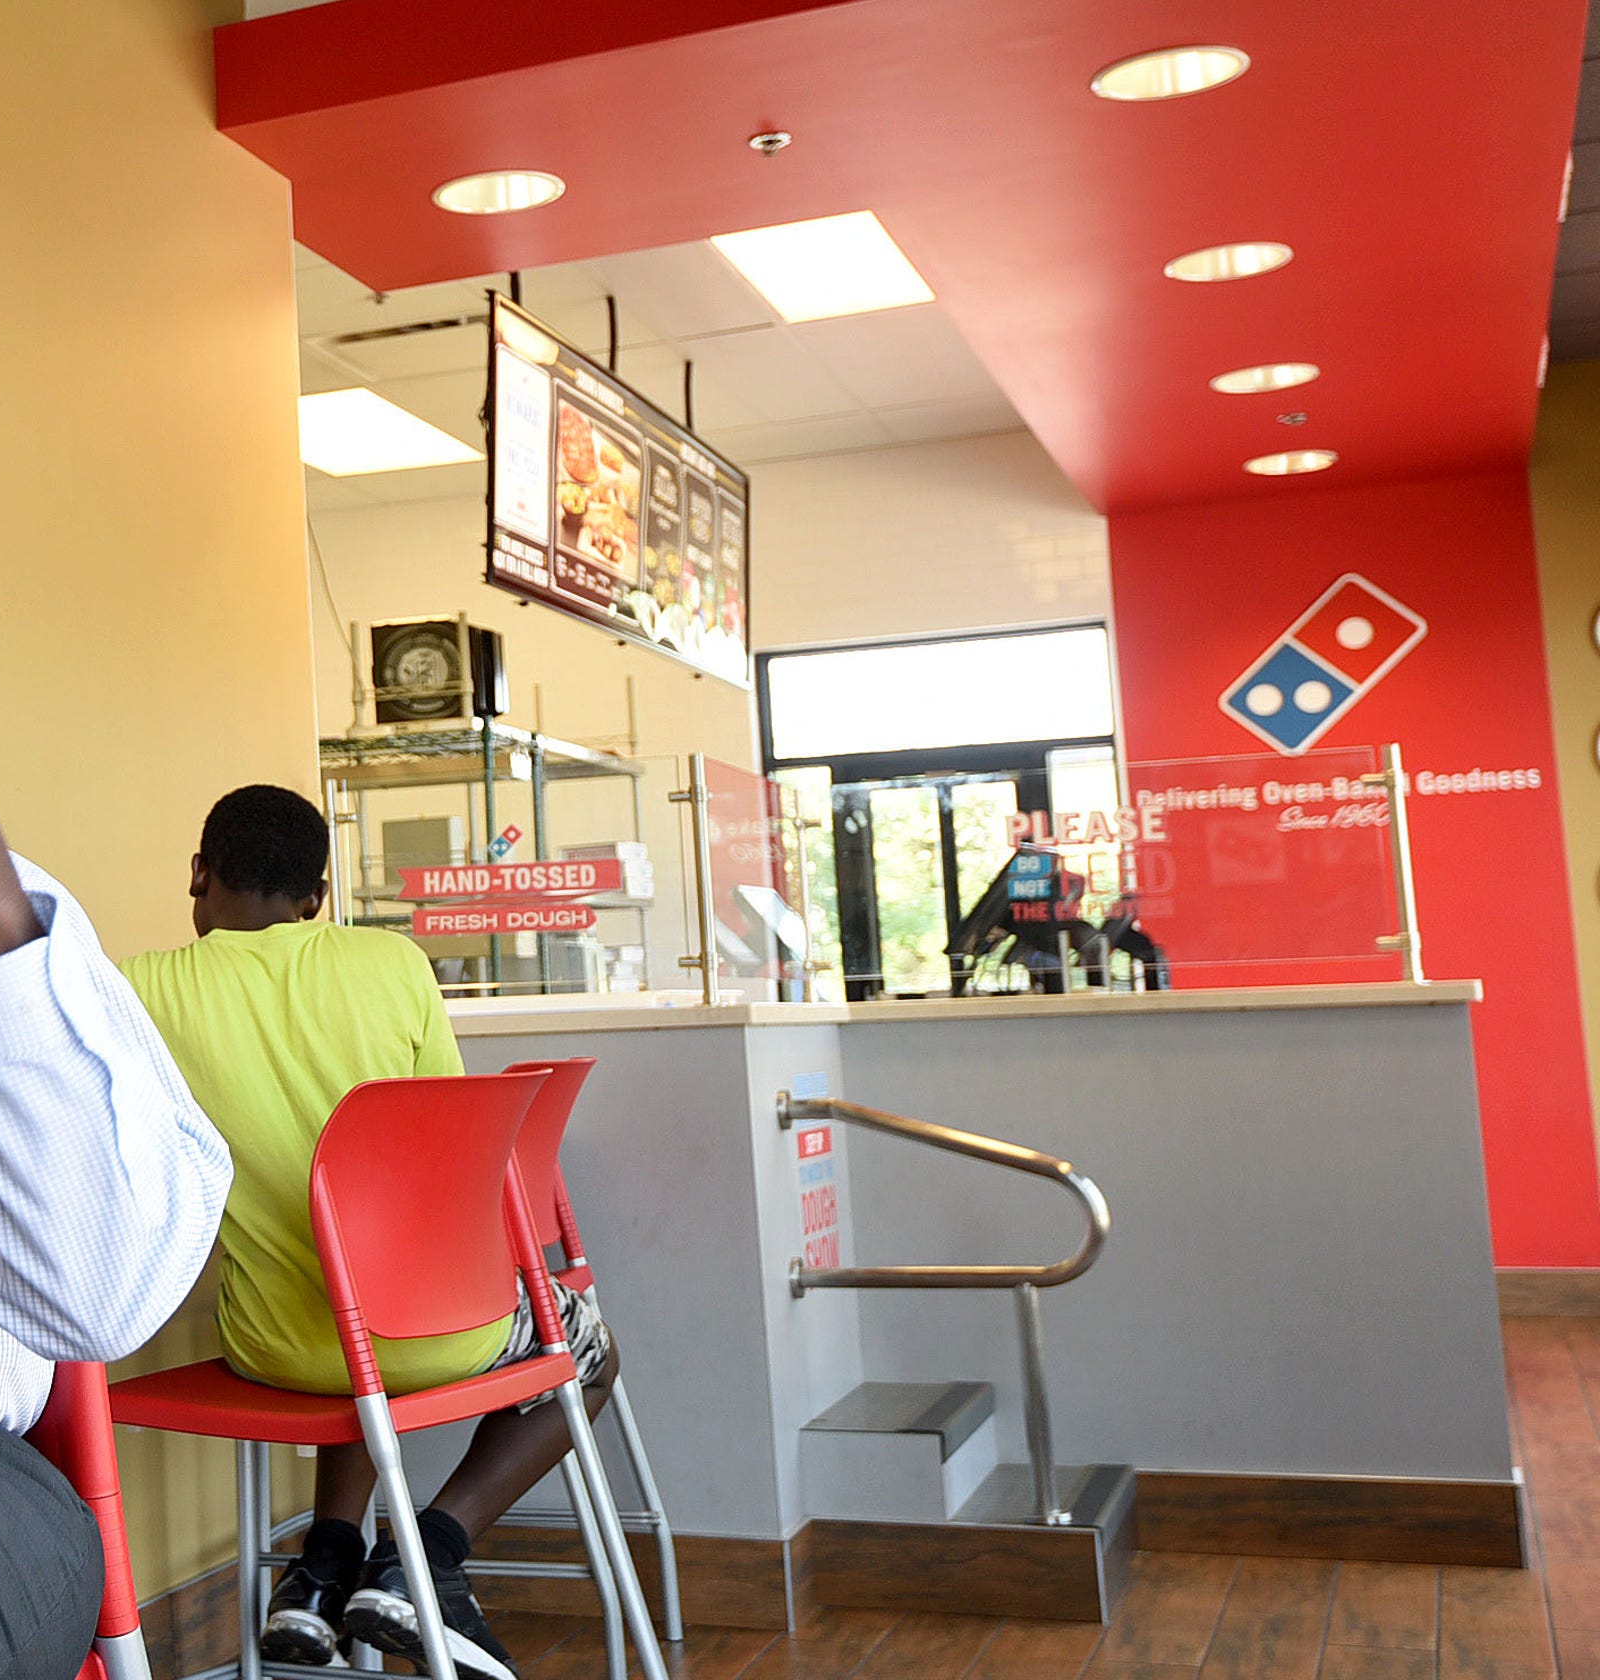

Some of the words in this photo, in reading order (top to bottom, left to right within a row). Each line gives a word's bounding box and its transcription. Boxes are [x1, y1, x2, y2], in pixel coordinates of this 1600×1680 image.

[1135, 785, 1259, 813] Delivering
[1415, 767, 1542, 796] Goodness
[1006, 806, 1172, 847] PLEASE
[1276, 805, 1328, 832] Since
[1016, 856, 1041, 873] DO
[423, 863, 597, 894] HAND-TOSSED
[1013, 880, 1048, 897] NOT
[425, 913, 499, 931] FRESH
[506, 909, 589, 928] DOUGH
[1010, 901, 1050, 922] THE
